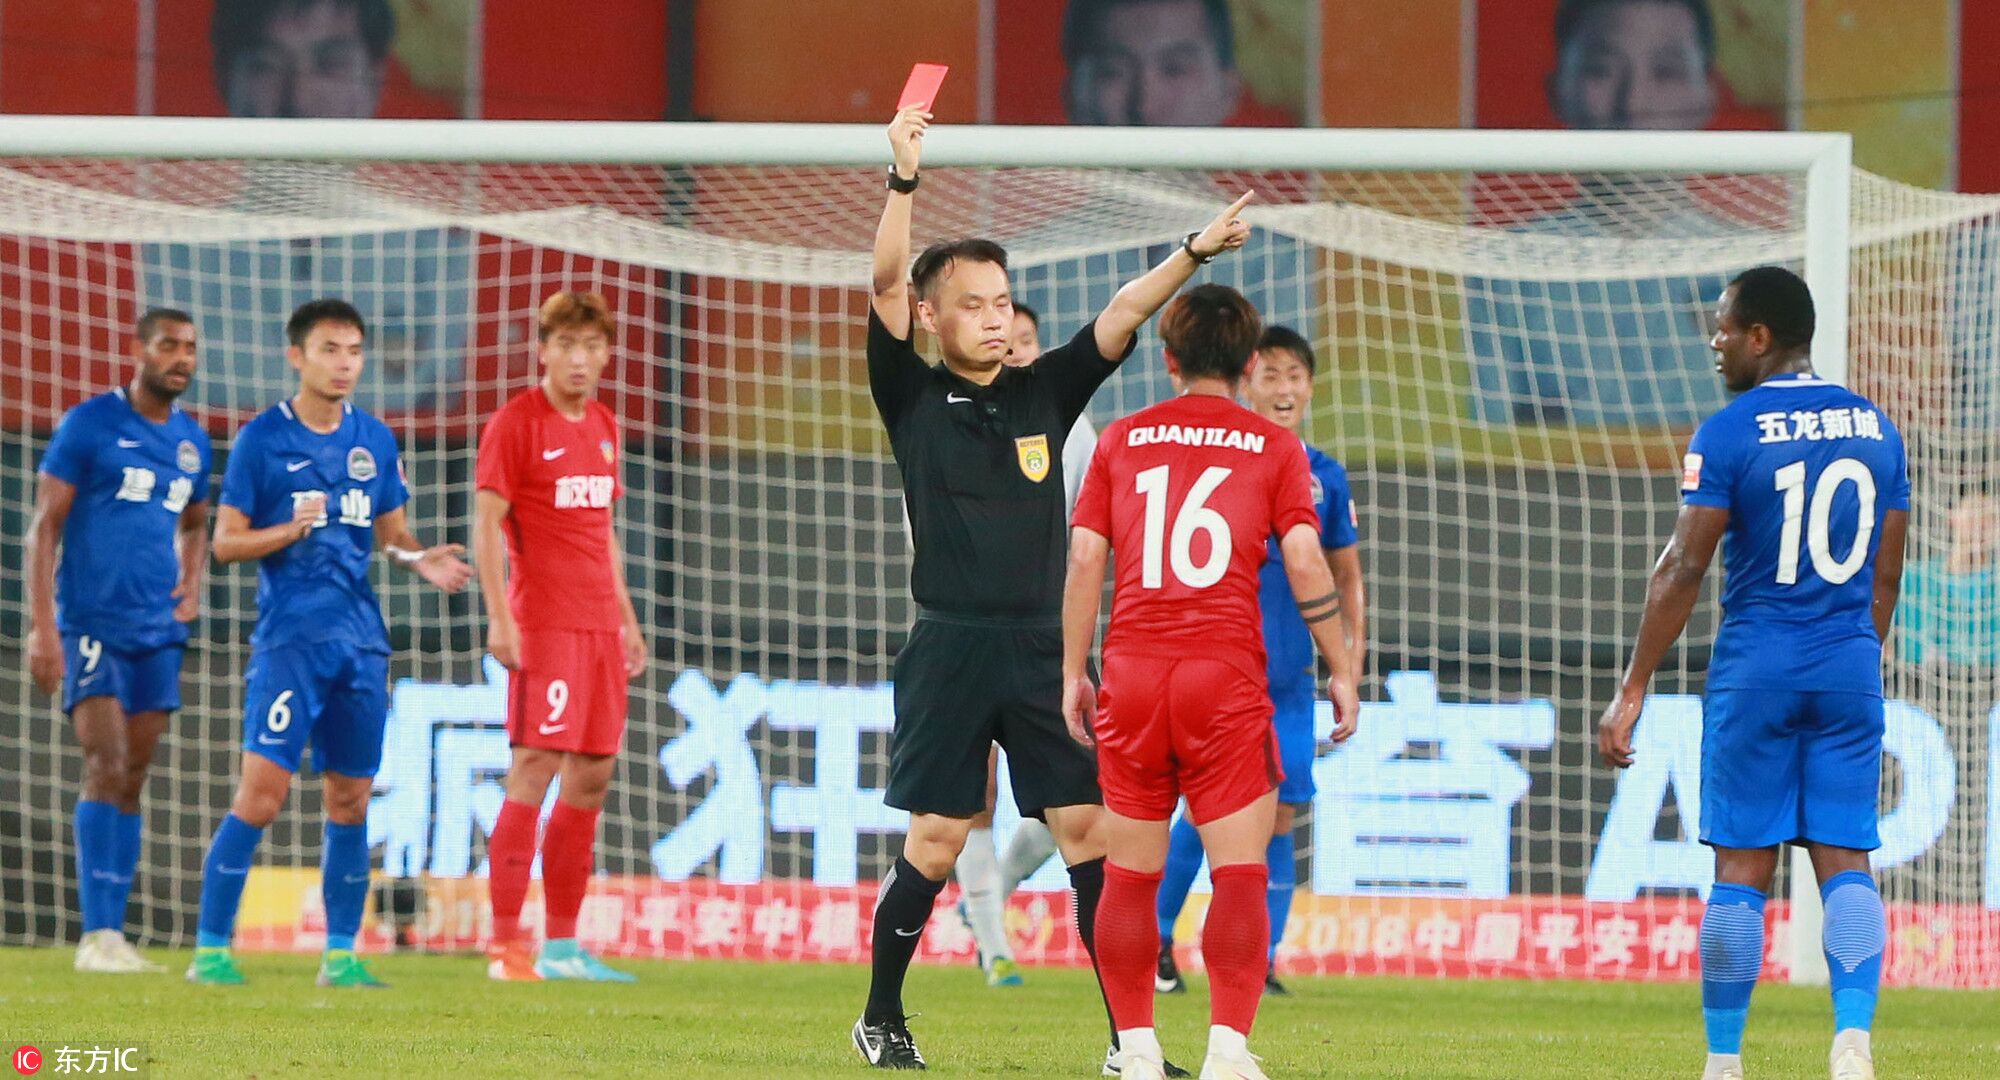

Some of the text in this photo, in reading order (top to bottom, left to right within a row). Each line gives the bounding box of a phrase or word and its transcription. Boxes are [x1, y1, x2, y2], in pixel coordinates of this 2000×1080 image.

[1755, 407, 1884, 444] 五龙新城
[115, 466, 194, 515] 建业
[1136, 464, 1233, 589] 16
[1775, 457, 1877, 585] 10
[79, 635, 102, 673] 9
[267, 689, 294, 733] 6
[546, 679, 569, 722] 9
